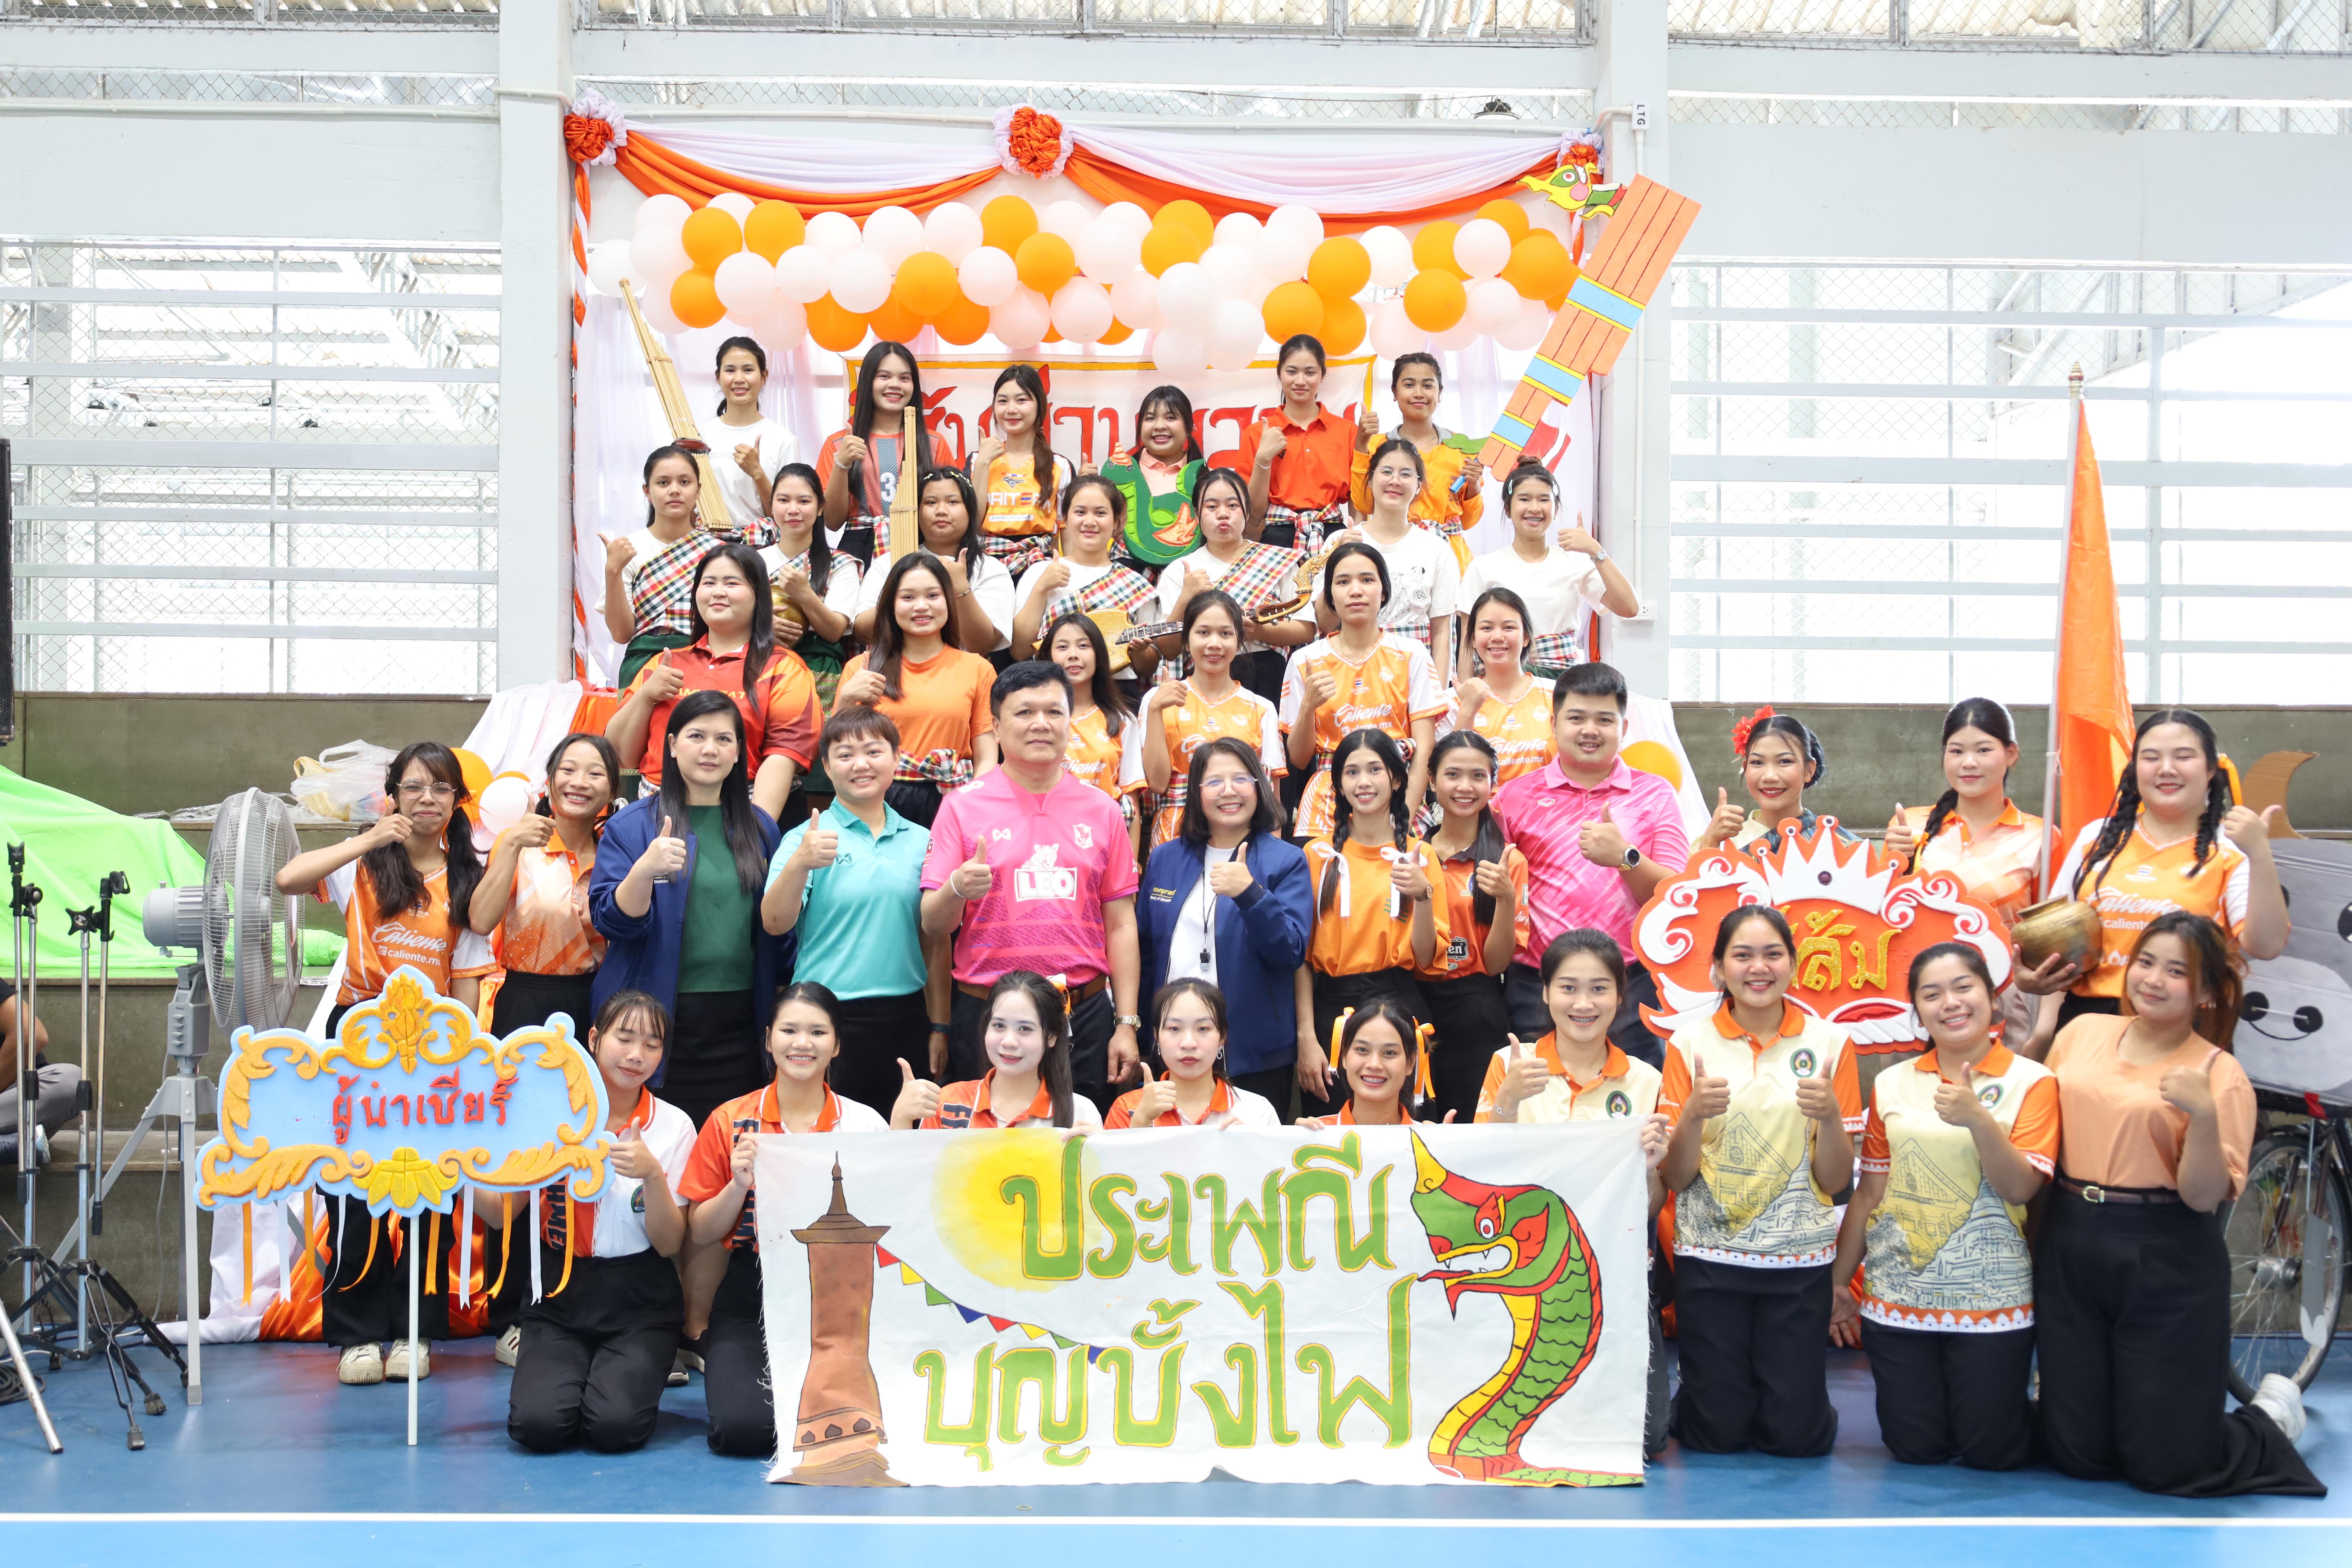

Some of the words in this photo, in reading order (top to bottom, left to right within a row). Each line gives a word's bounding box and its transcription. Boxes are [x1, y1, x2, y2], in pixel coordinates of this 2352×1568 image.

[1637, 104, 1646, 125] LTG
[880, 472, 896, 502] 3
[1331, 703, 1392, 727] Caliente
[957, 780, 985, 793] BG
[1018, 871, 1074, 897] LEO
[371, 921, 447, 952] Caliente
[1000, 1130, 1397, 1281] ประเพณี
[913, 1273, 1419, 1472] บุญบั้งไฟ
